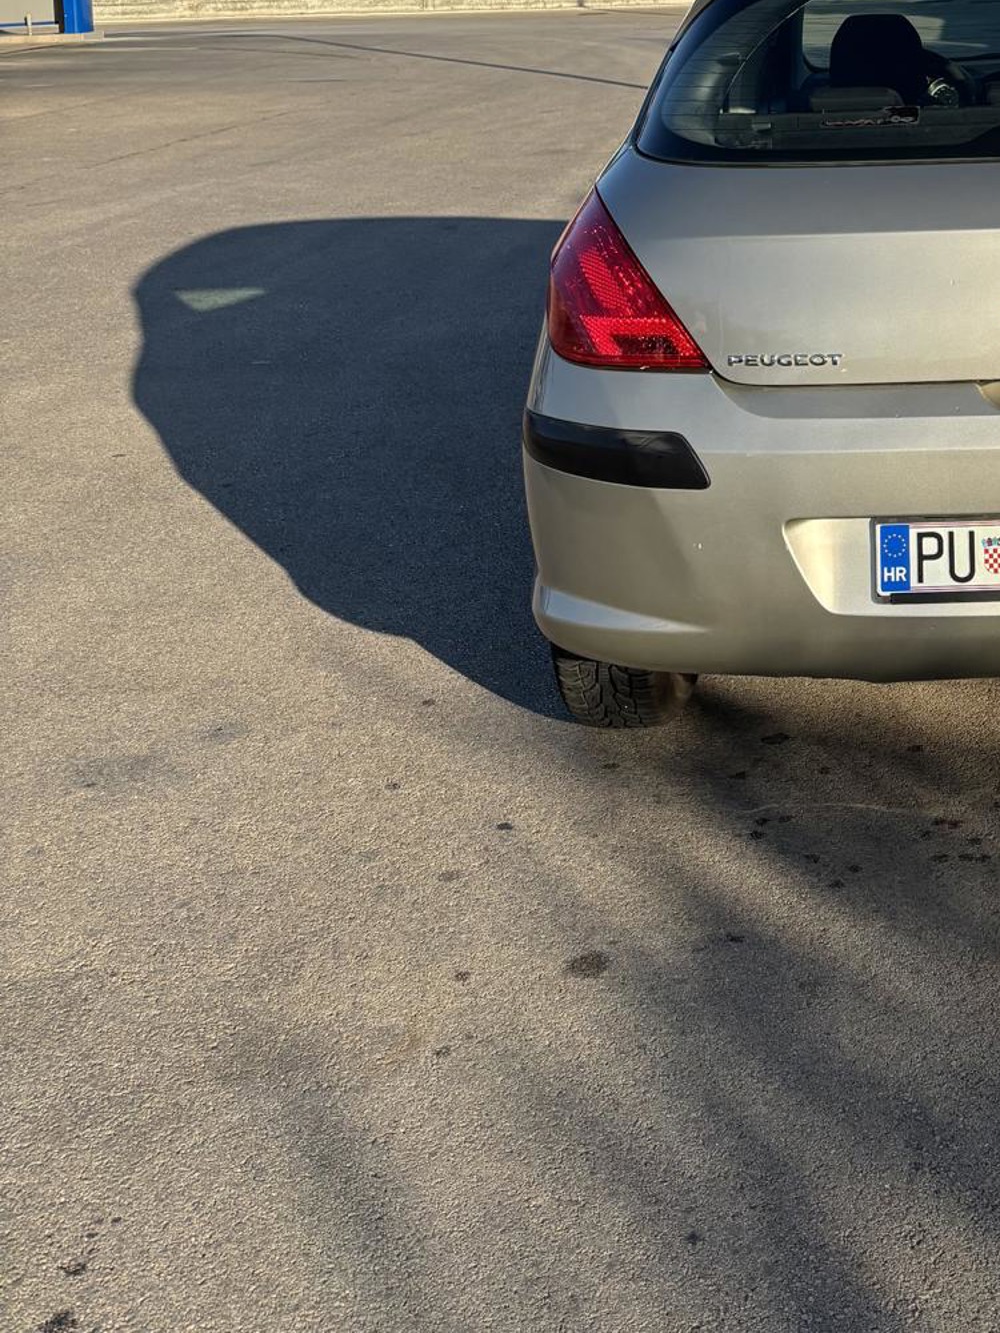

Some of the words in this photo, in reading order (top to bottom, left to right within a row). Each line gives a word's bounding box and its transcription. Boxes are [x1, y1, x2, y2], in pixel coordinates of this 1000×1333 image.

[727, 353, 843, 367] PEUGEOT
[916, 530, 975, 584] PU
[883, 567, 907, 583] HR
